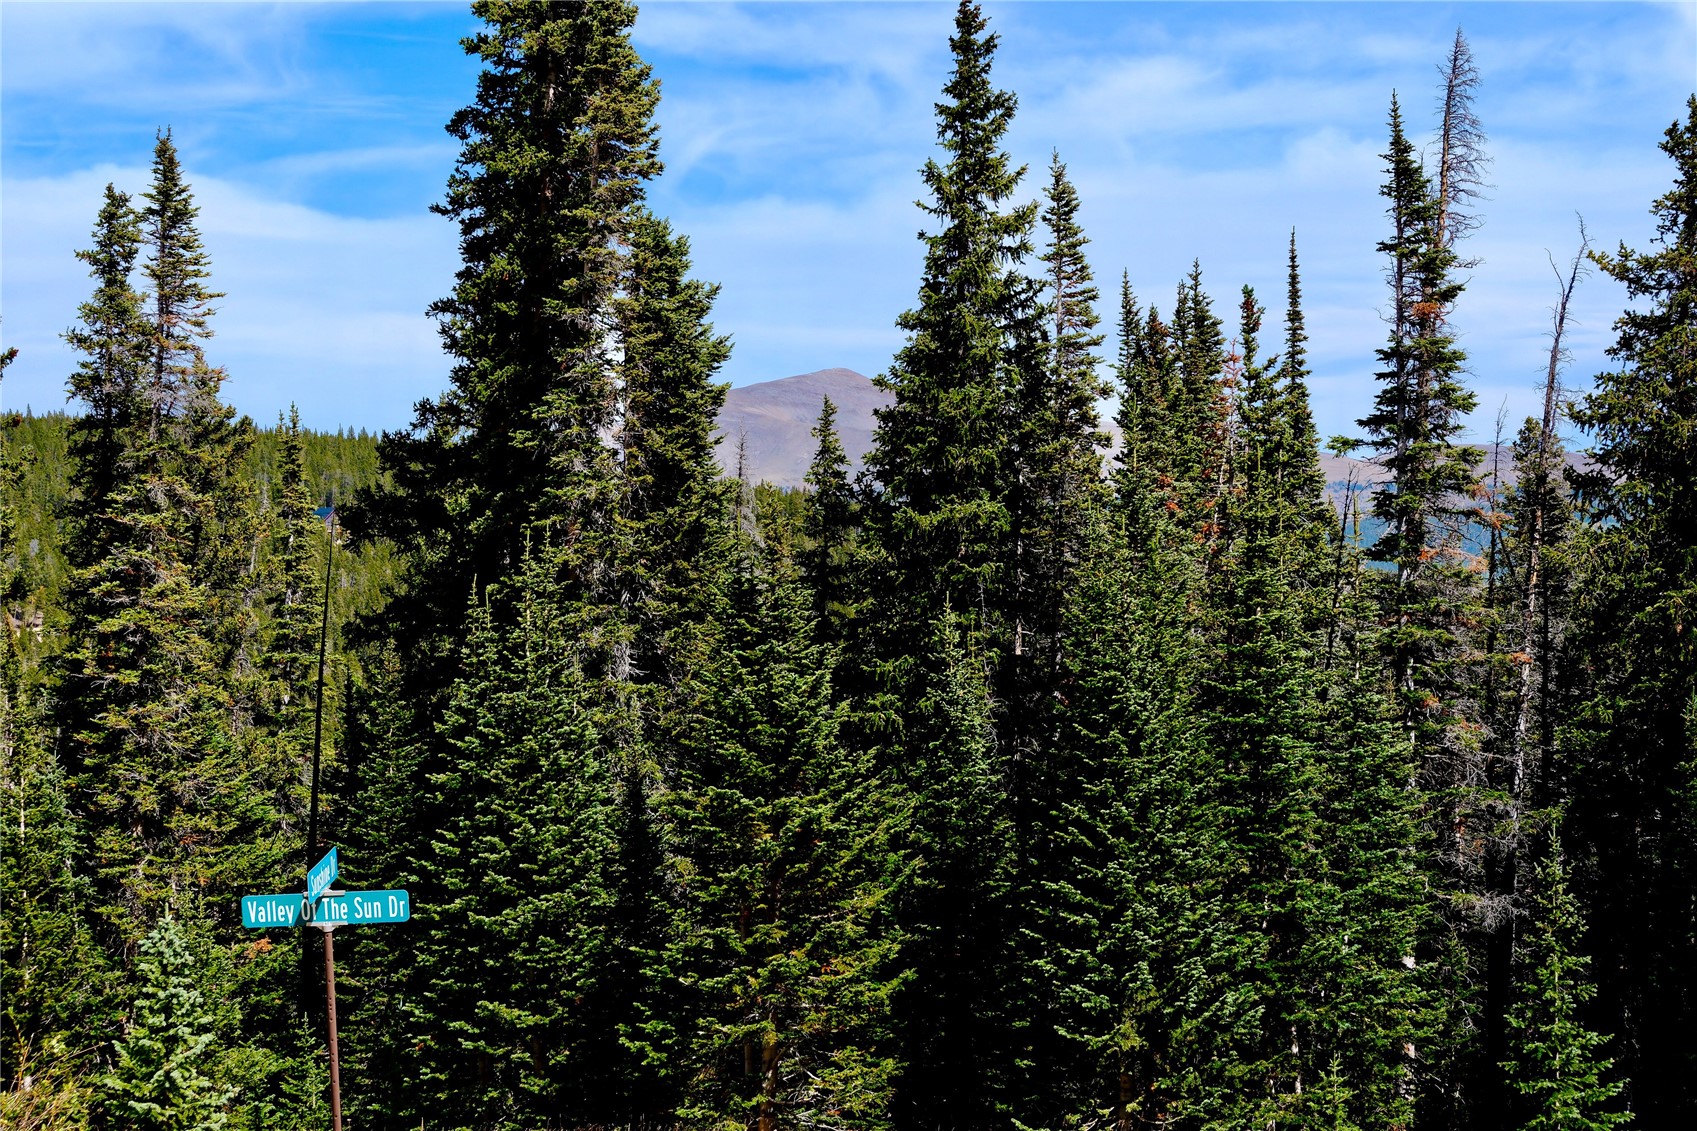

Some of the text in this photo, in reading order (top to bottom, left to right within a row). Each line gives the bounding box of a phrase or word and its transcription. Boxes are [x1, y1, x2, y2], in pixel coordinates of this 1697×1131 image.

[310, 855, 337, 897] Sunshine Dr
[247, 895, 406, 924] Valley Of The Sun Dr
